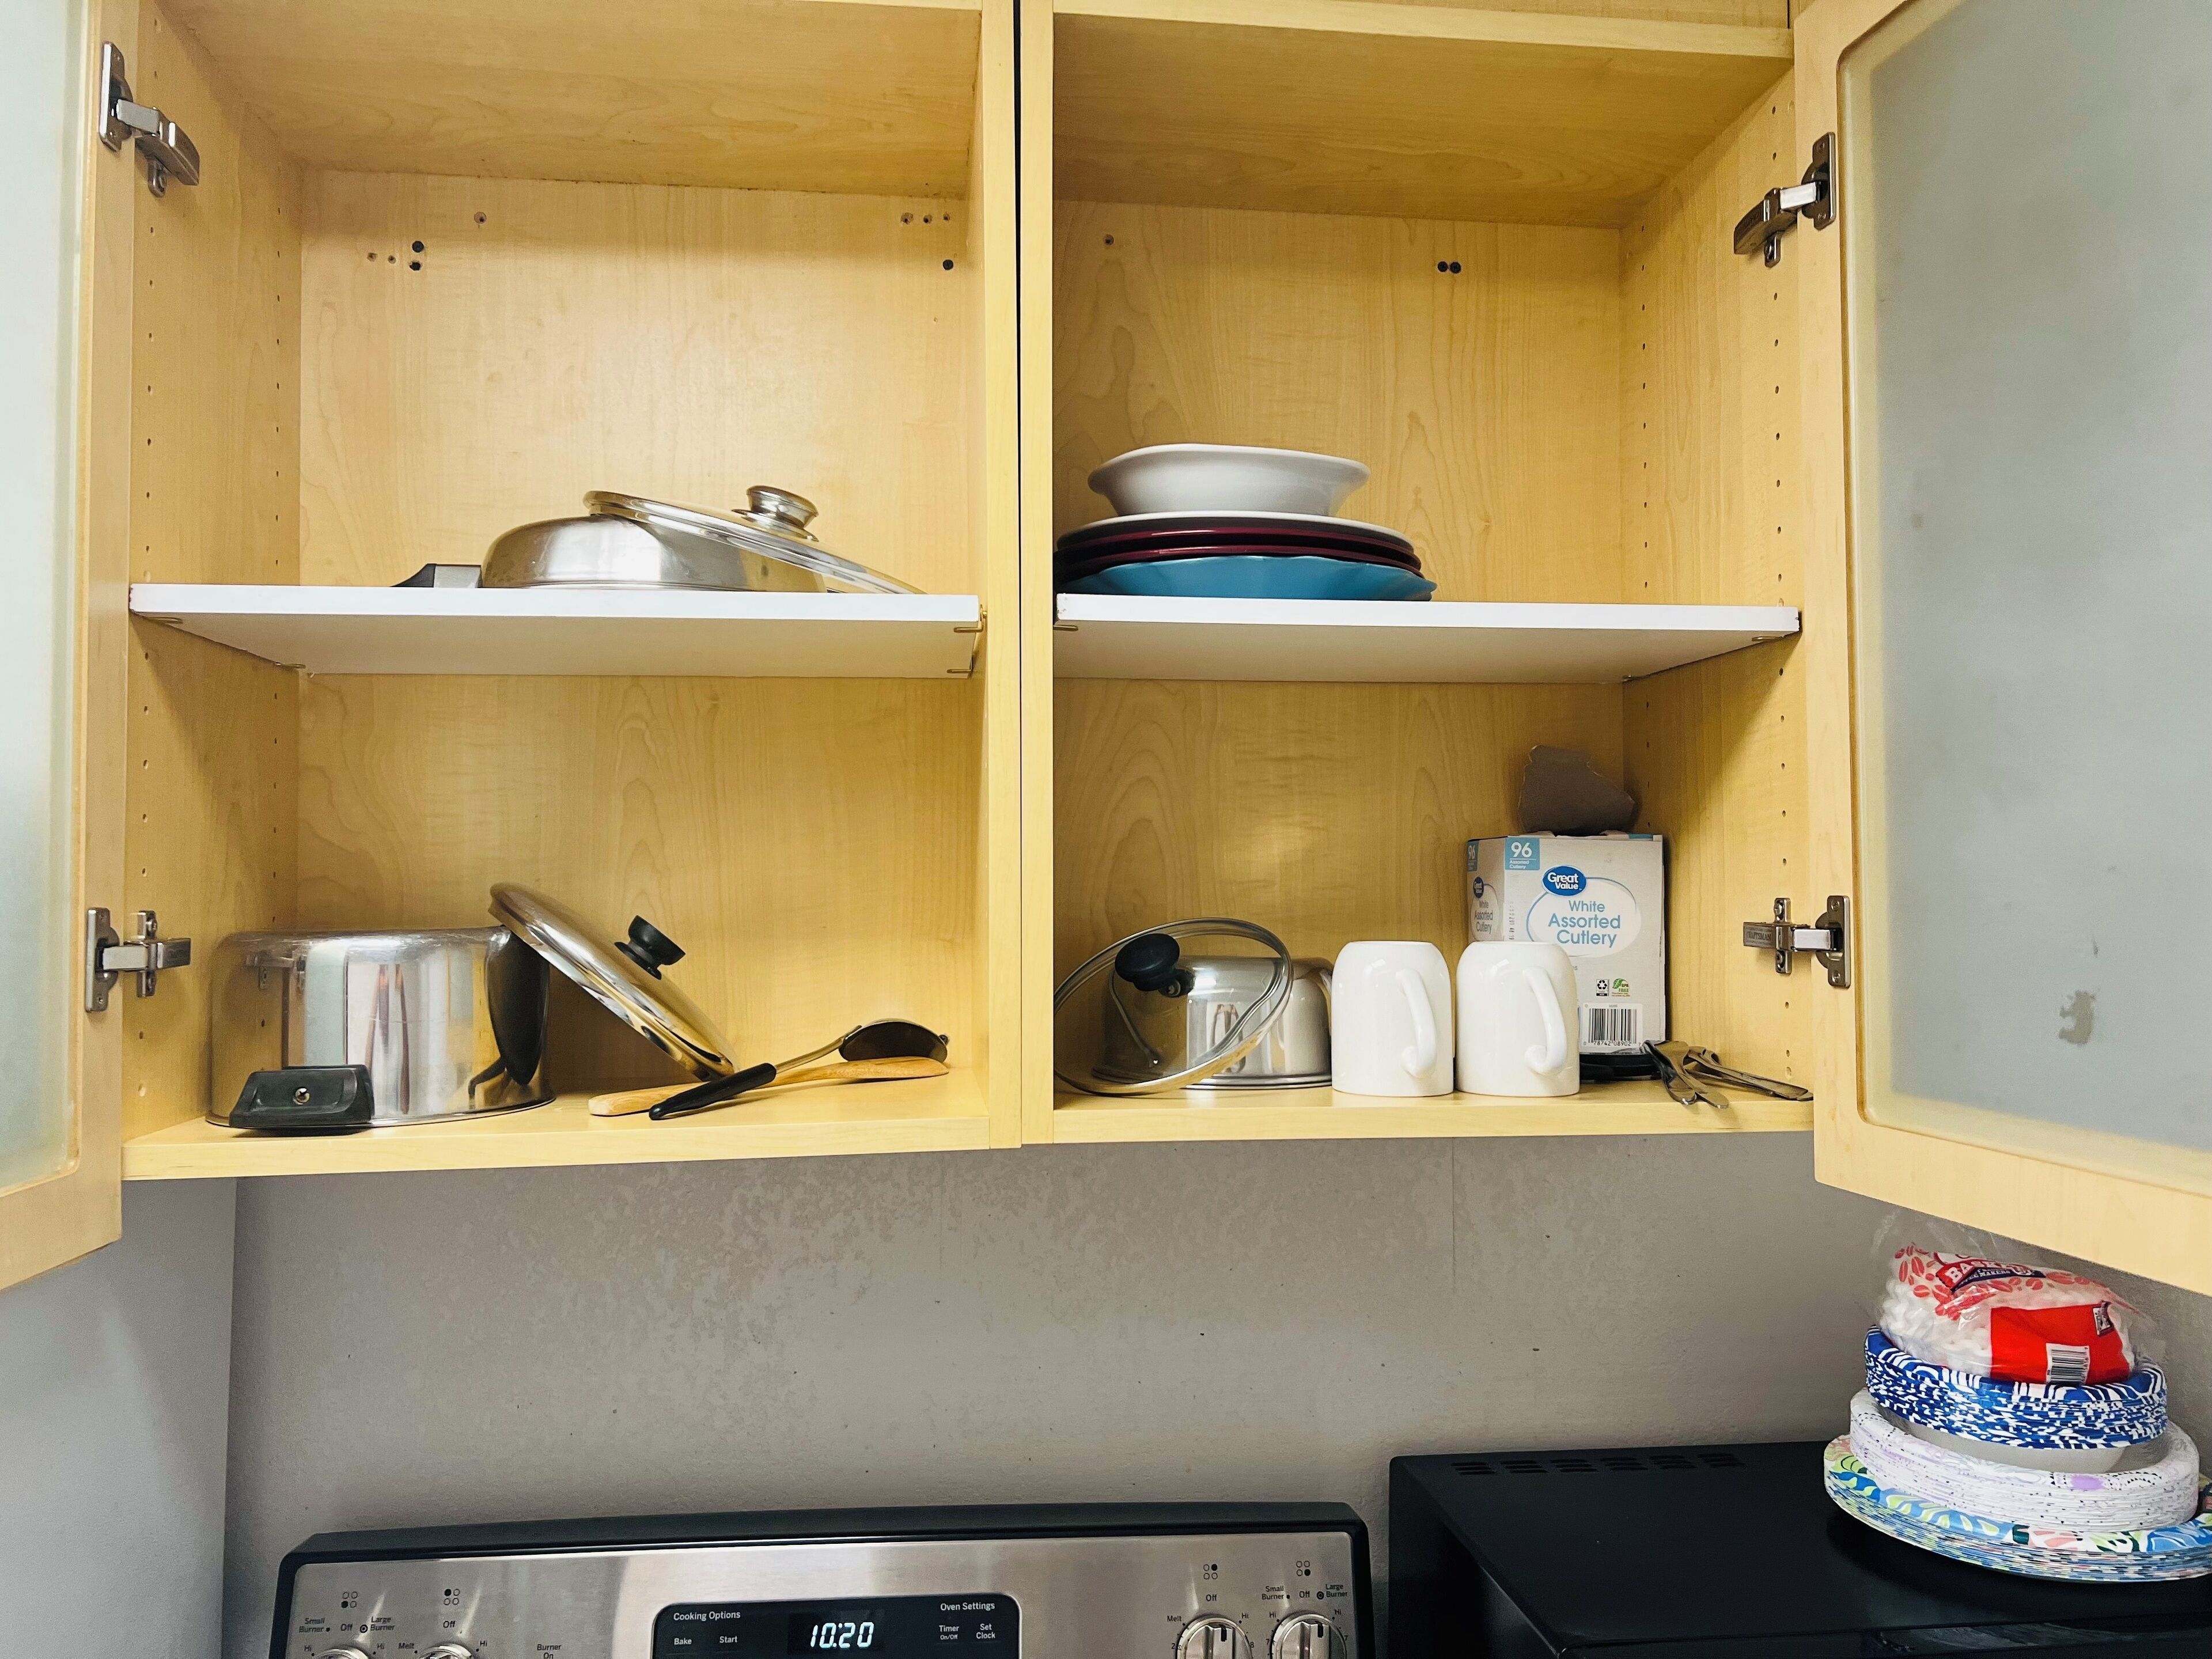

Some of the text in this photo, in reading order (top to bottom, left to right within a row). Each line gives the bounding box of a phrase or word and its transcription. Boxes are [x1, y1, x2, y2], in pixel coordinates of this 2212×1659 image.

[1510, 842, 1532, 858] 96
[1547, 872, 1579, 882] Great
[1555, 881, 1579, 889] Value
[1568, 900, 1605, 912] White
[1474, 910, 1493, 921] Assorted
[1548, 913, 1620, 929] Assorted
[1476, 922, 1492, 934] Cutlery
[1556, 929, 1617, 948] Cutlery
[1206, 1594, 1217, 1602] Off
[962, 1602, 995, 1611] Settings
[371, 1616, 392, 1624] Large
[673, 1611, 741, 1621] Cooking Options
[340, 1623, 353, 1631] Off
[443, 1620, 456, 1628] Off
[939, 1624, 960, 1633] Timer
[719, 1635, 738, 1644] Start
[976, 1631, 996, 1639] Clock
[673, 1637, 692, 1645] Bake
